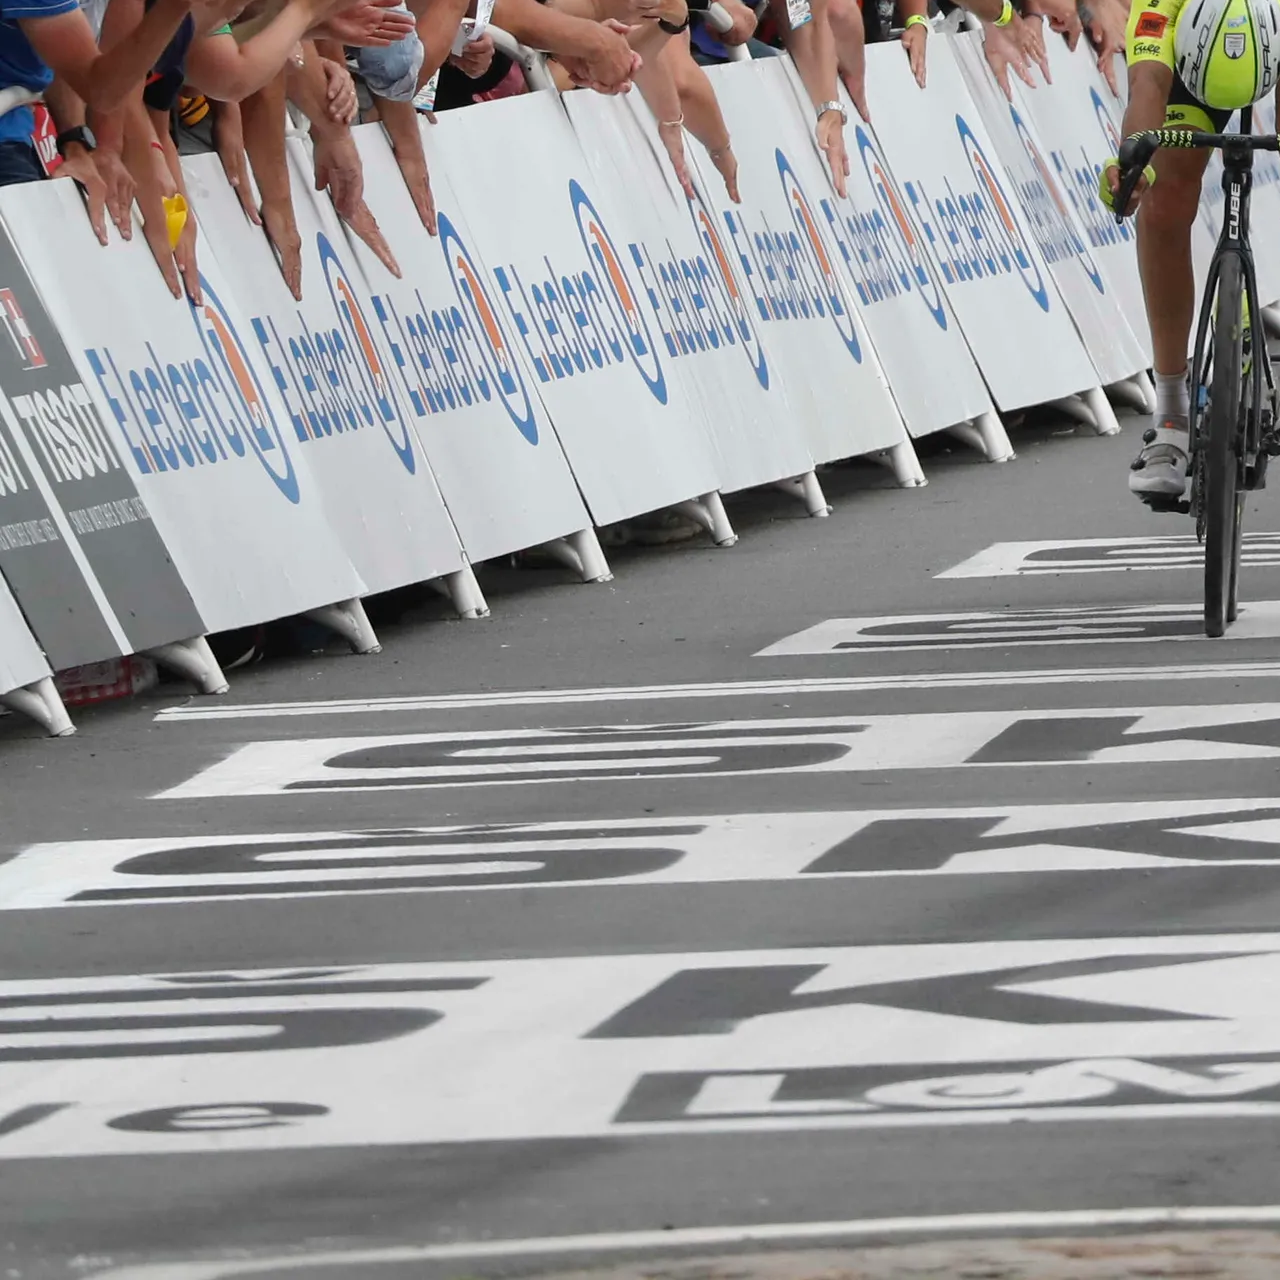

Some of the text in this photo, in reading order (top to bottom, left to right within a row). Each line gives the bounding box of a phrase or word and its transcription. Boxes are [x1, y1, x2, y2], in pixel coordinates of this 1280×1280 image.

[1228, 181, 1241, 241] CUBE
[250, 310, 375, 443] E.Leclerc
[371, 288, 492, 418] E.Leclerc
[493, 255, 625, 384] E.Leclerc
[11, 383, 121, 483] TISSOT
[84, 341, 246, 475] E.Leclerc
[0, 1100, 331, 1135] e
